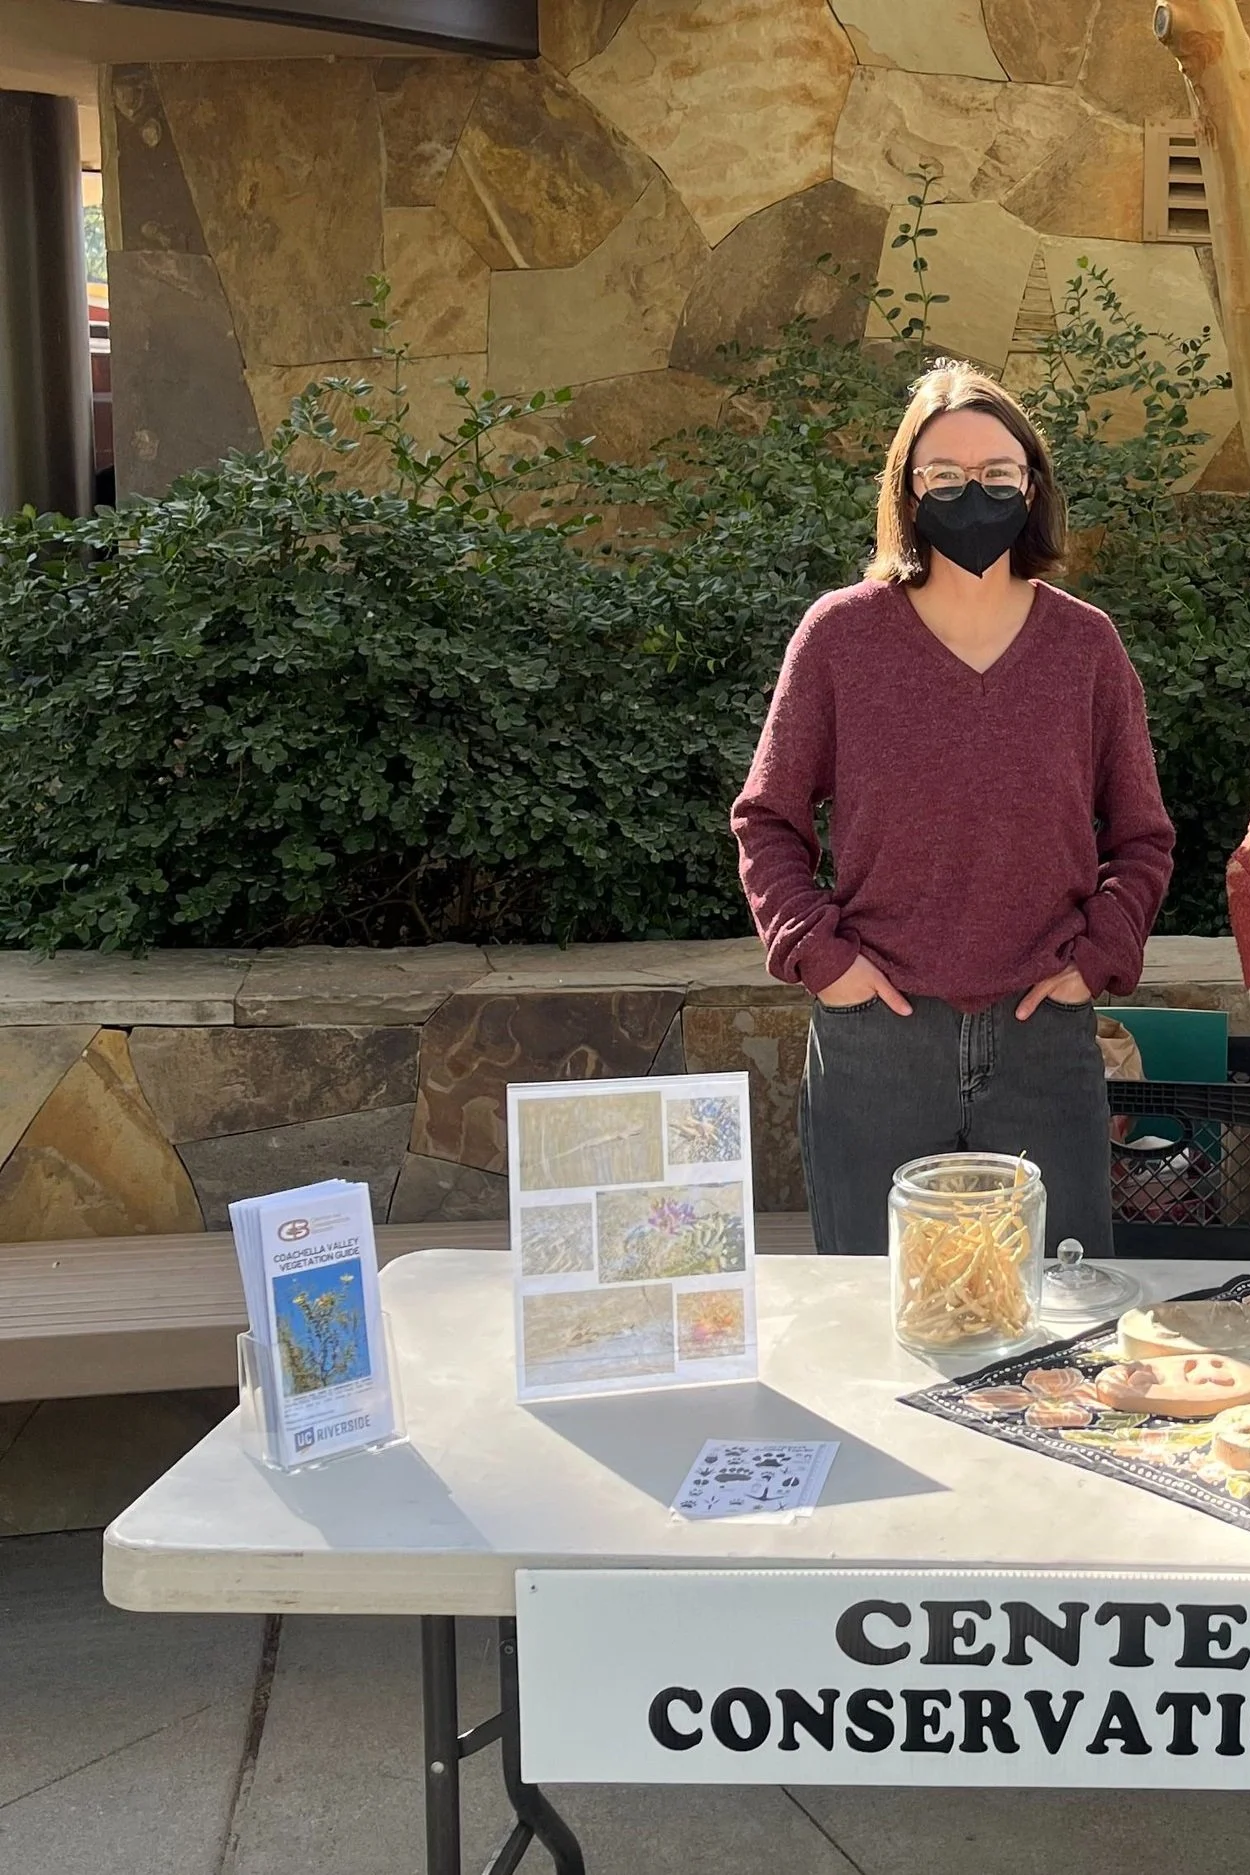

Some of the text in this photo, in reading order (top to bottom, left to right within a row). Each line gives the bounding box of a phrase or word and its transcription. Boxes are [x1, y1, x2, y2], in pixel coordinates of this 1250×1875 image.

[273, 1237, 359, 1263] COACHELLA VALLEY
[280, 1247, 360, 1272] VEGETATION GUIDE
[296, 1430, 314, 1449] UC
[317, 1415, 371, 1441] RIVERSIDE
